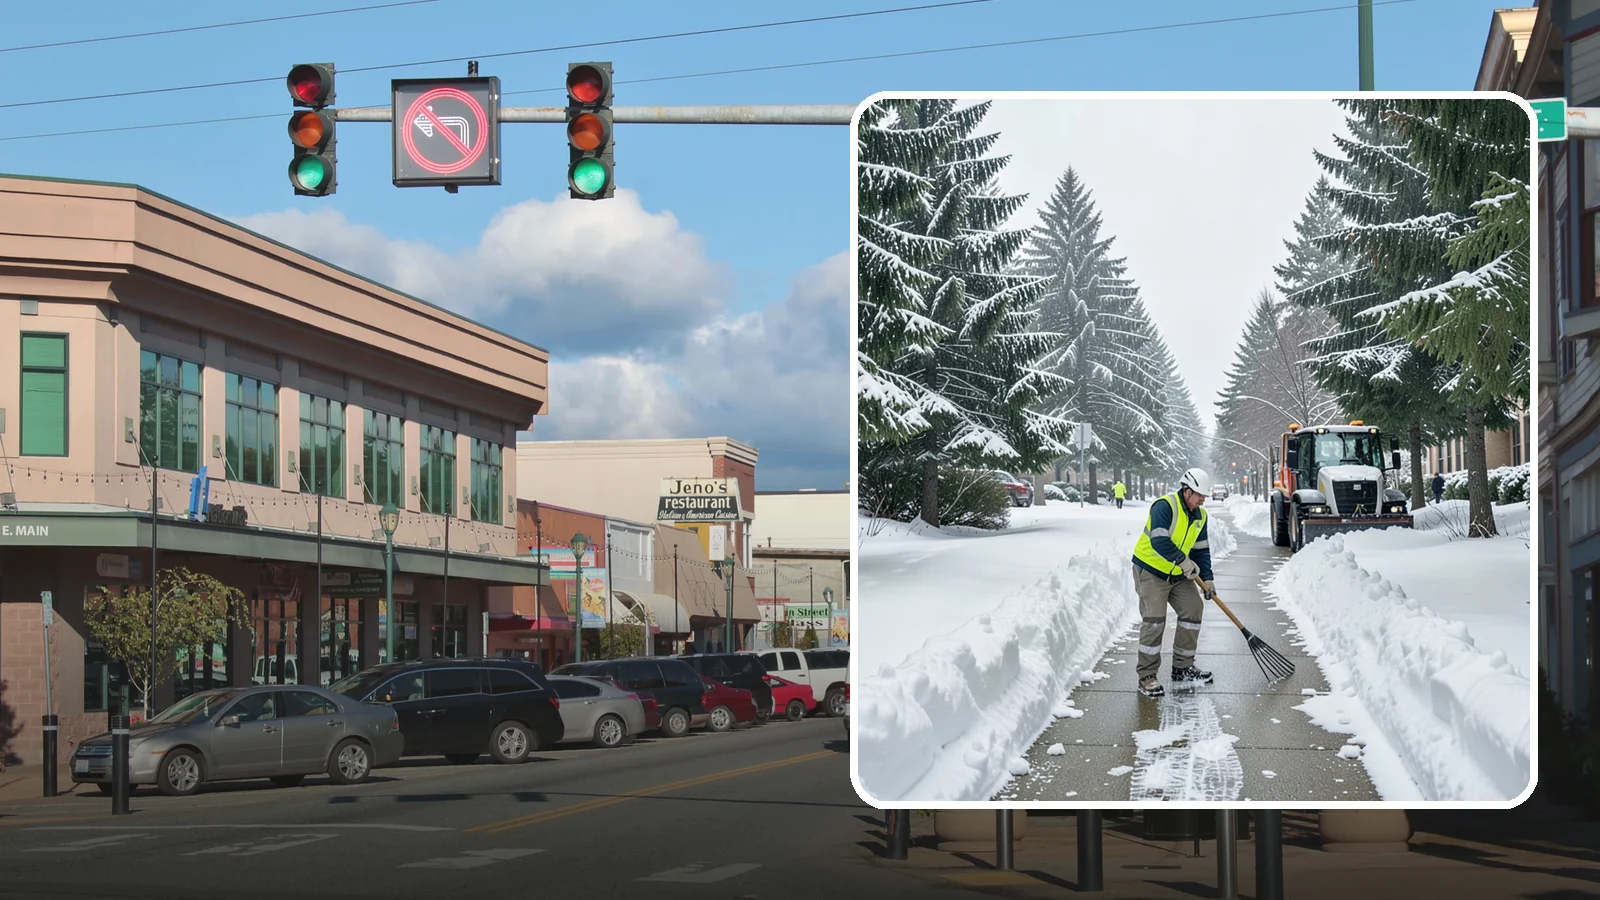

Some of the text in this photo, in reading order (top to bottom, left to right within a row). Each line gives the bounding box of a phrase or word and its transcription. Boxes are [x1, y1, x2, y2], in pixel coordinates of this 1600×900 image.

[669, 480, 727, 494] Jeno's
[665, 496, 731, 509] restaurant
[658, 510, 681, 519] Italian
[686, 509, 714, 519] American
[715, 509, 738, 519] Cuisine
[2, 525, 49, 536] E. MAIN
[785, 607, 829, 617] in Street
[790, 619, 824, 628] lass
